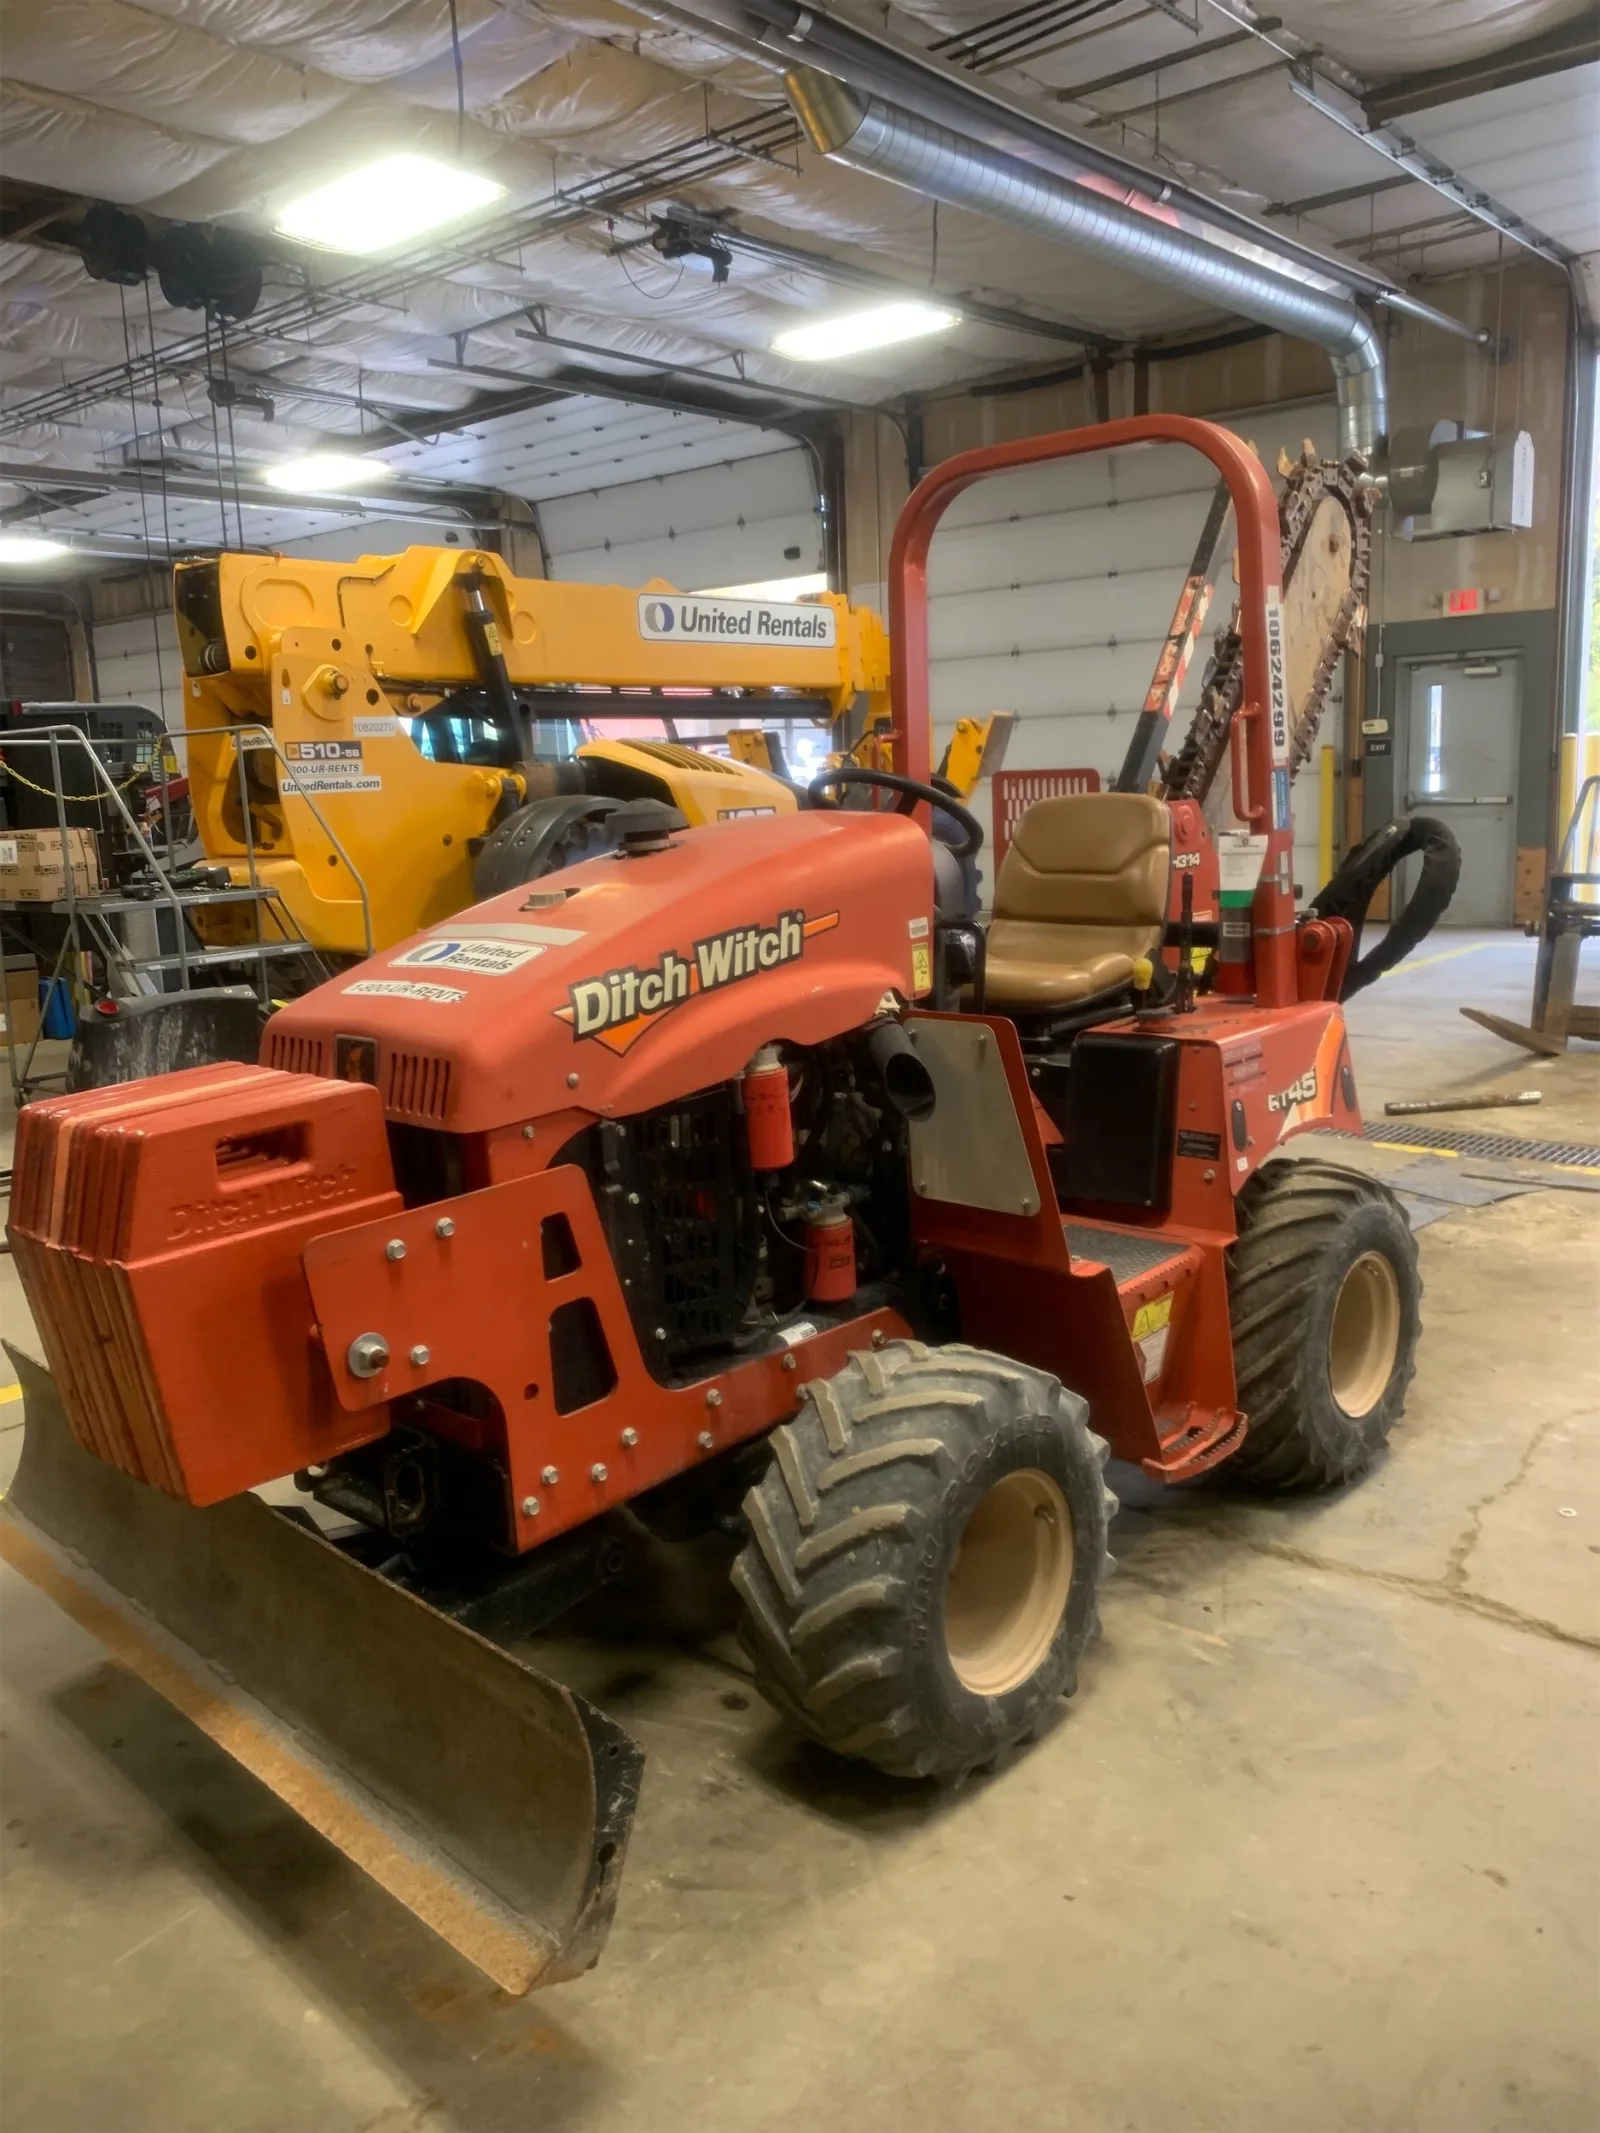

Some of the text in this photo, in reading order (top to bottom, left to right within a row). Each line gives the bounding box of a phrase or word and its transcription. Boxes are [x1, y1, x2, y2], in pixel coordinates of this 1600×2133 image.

[681, 605, 827, 639] United Rentals
[1268, 604, 1285, 747] 10624299
[446, 952, 514, 971] Rentals
[460, 943, 527, 960] United
[574, 914, 802, 1035] Ditch Witch
